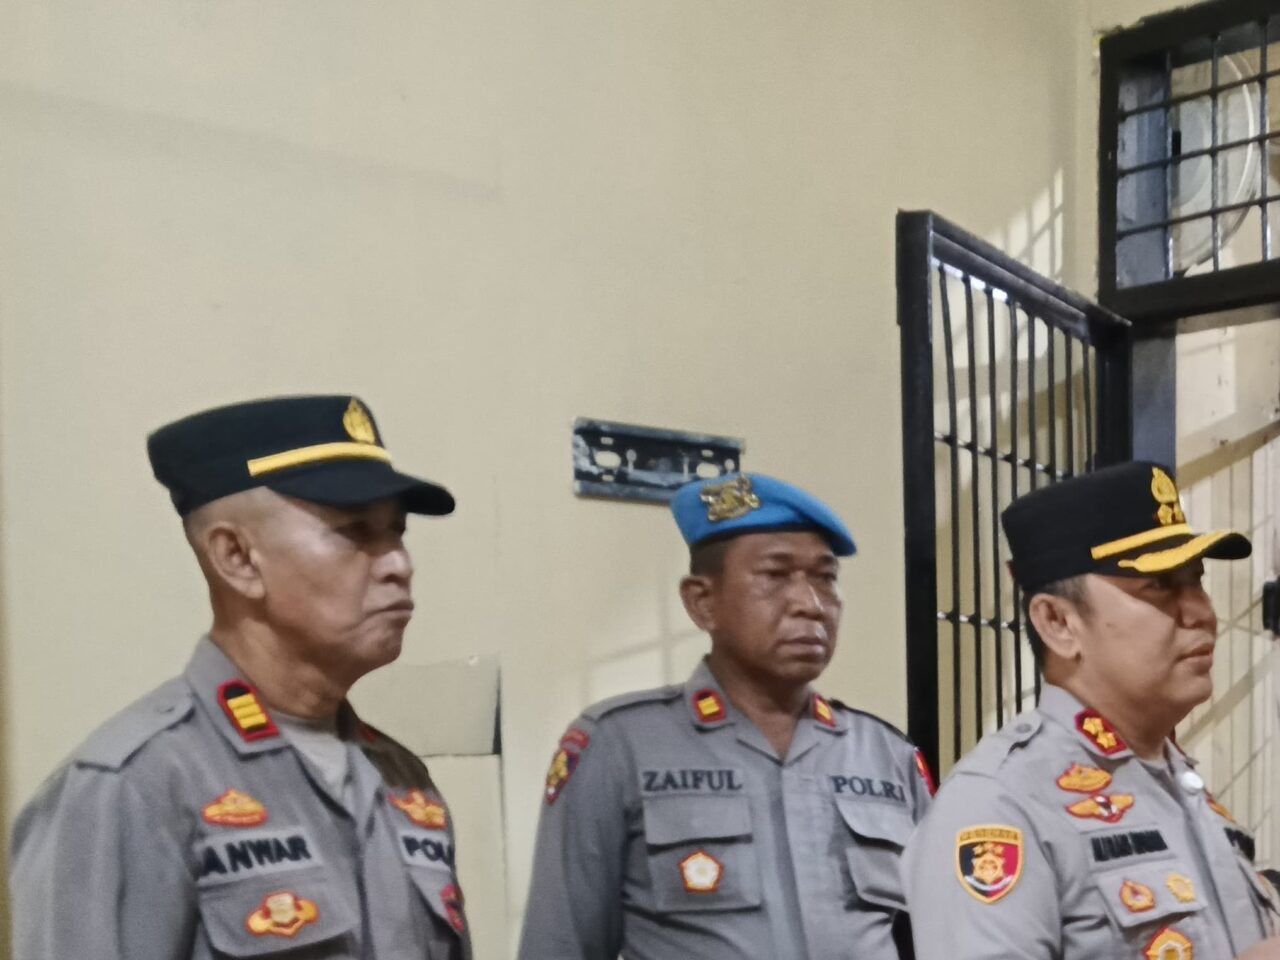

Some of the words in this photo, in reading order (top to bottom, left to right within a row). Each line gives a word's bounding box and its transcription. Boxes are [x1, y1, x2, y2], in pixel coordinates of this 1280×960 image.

[642, 769, 743, 792] ZAIFUL
[830, 774, 907, 803] POLRI
[196, 835, 312, 879] ANWAR
